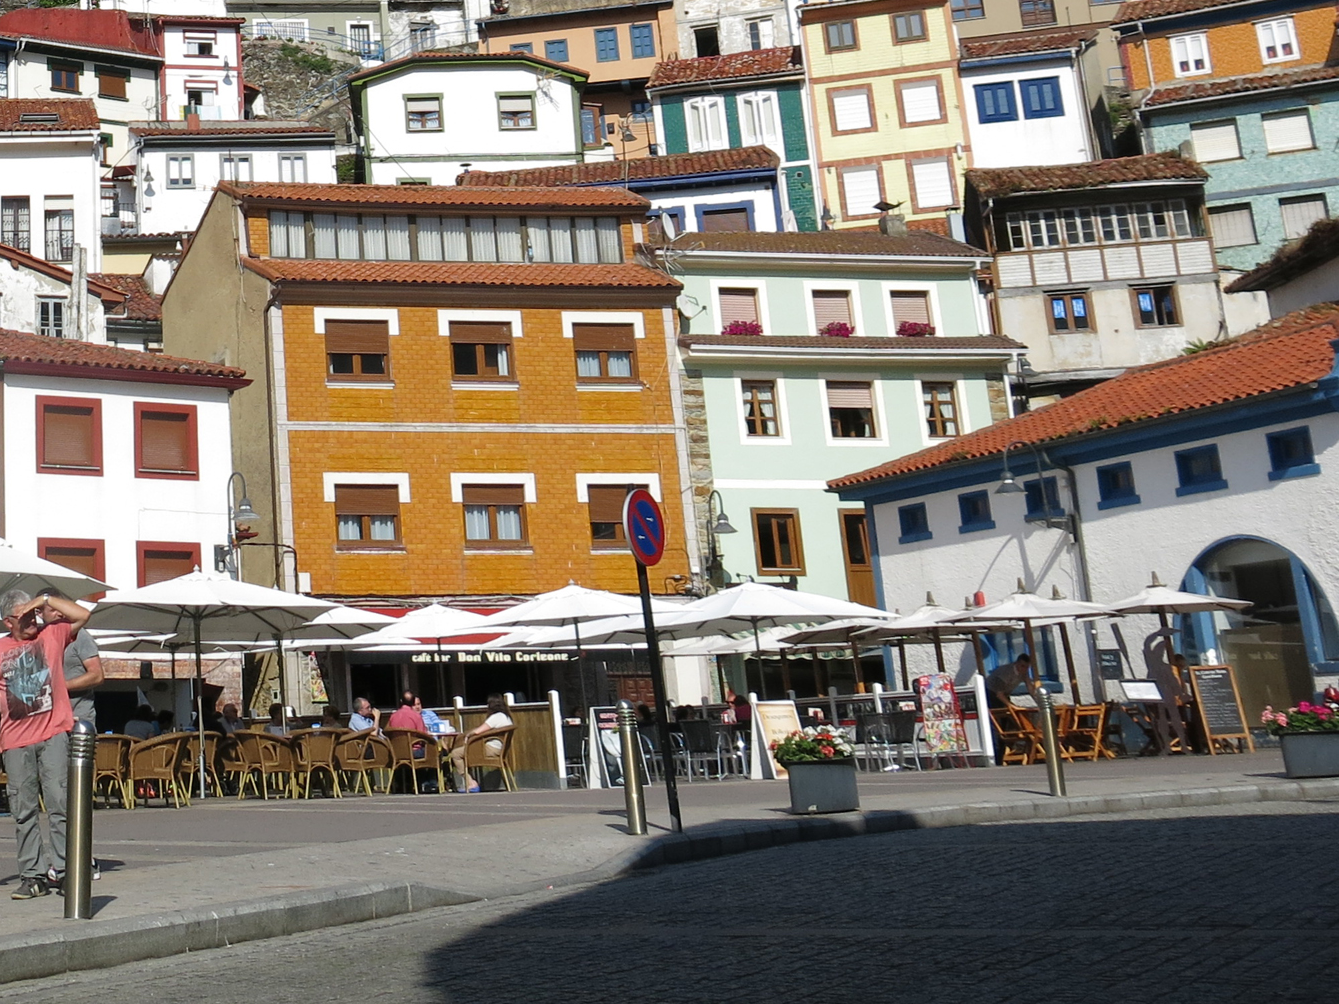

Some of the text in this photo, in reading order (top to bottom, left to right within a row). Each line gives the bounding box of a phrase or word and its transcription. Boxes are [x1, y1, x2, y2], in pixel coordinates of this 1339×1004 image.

[457, 652, 482, 662] Don
[485, 652, 511, 662] Vito
[515, 652, 569, 662] Corleone
